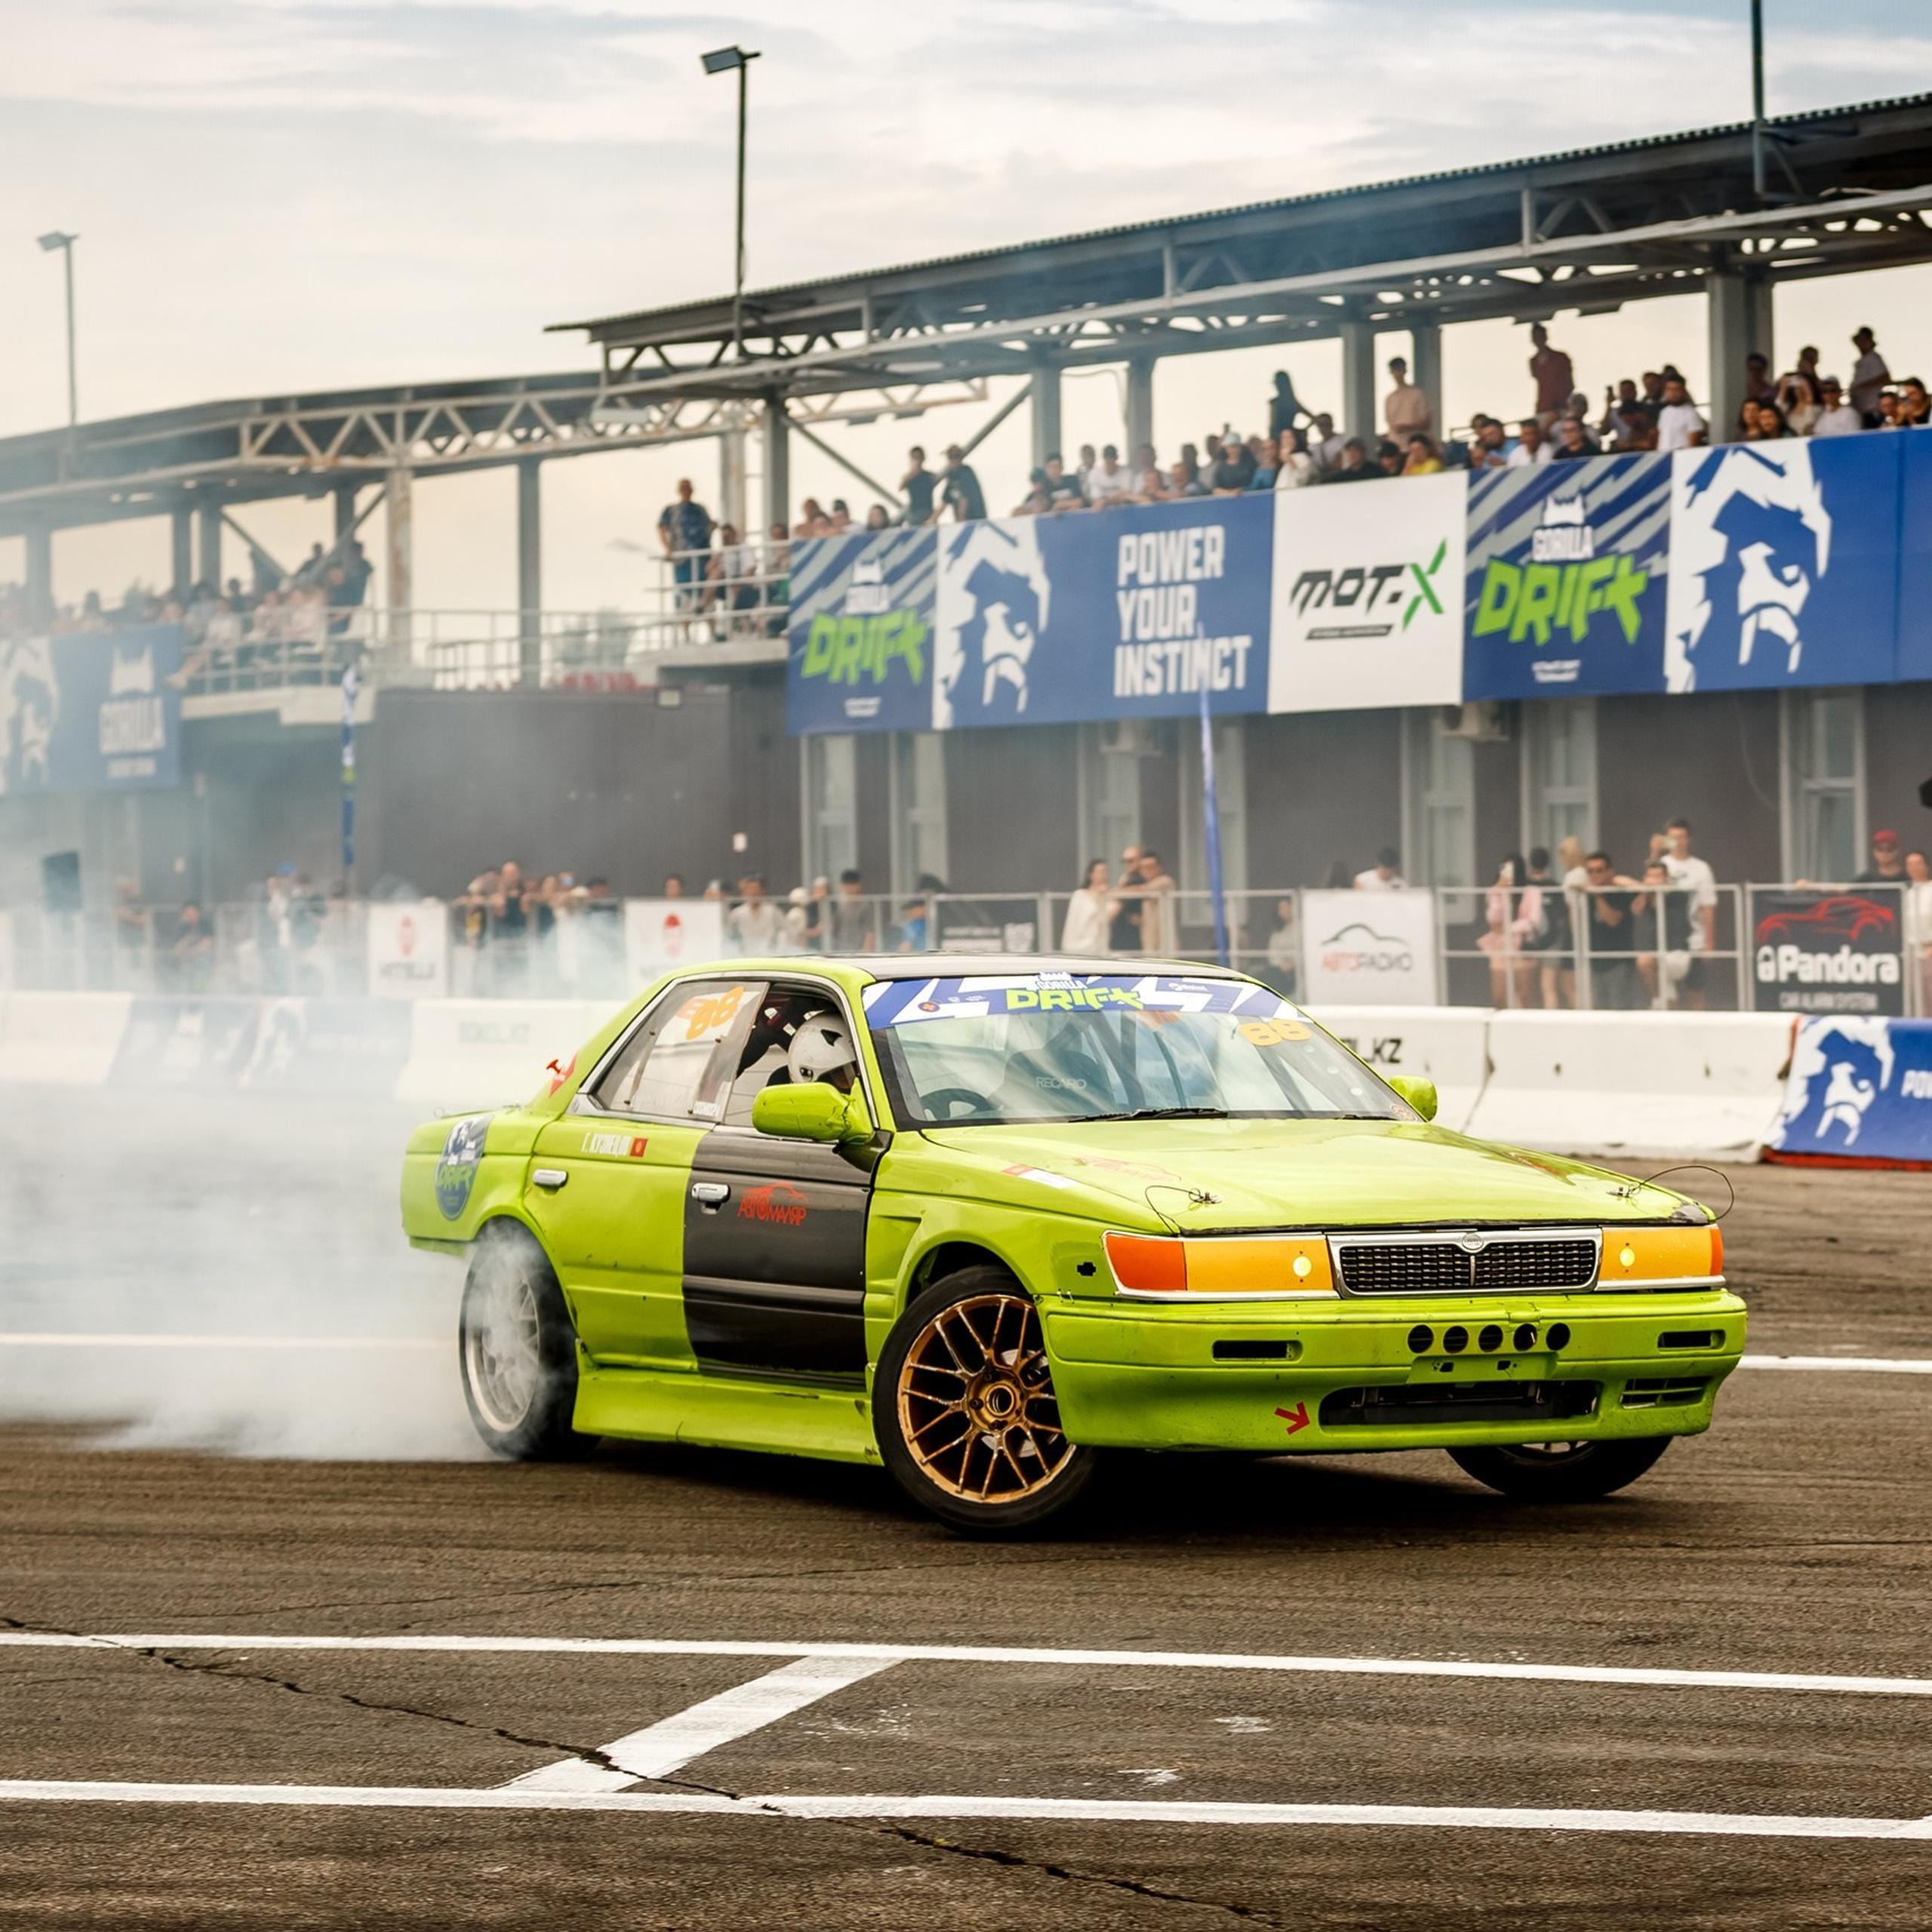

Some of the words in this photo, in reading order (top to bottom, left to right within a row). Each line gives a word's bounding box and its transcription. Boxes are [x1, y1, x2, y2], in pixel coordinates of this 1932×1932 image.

[1118, 525, 1225, 586] POWER
[1117, 583, 1197, 641] YOUR
[1473, 554, 1649, 645] DRIFT
[801, 608, 927, 685] DRIFT
[1114, 635, 1252, 697] INSTINCT
[1037, 980, 1087, 990] GORILLA
[1777, 944, 1900, 984] Pandora
[685, 985, 745, 1041] 88
[1006, 987, 1143, 1010] DRIFT
[1238, 1019, 1311, 1047] 88
[1036, 1076, 1087, 1090] RECARO
